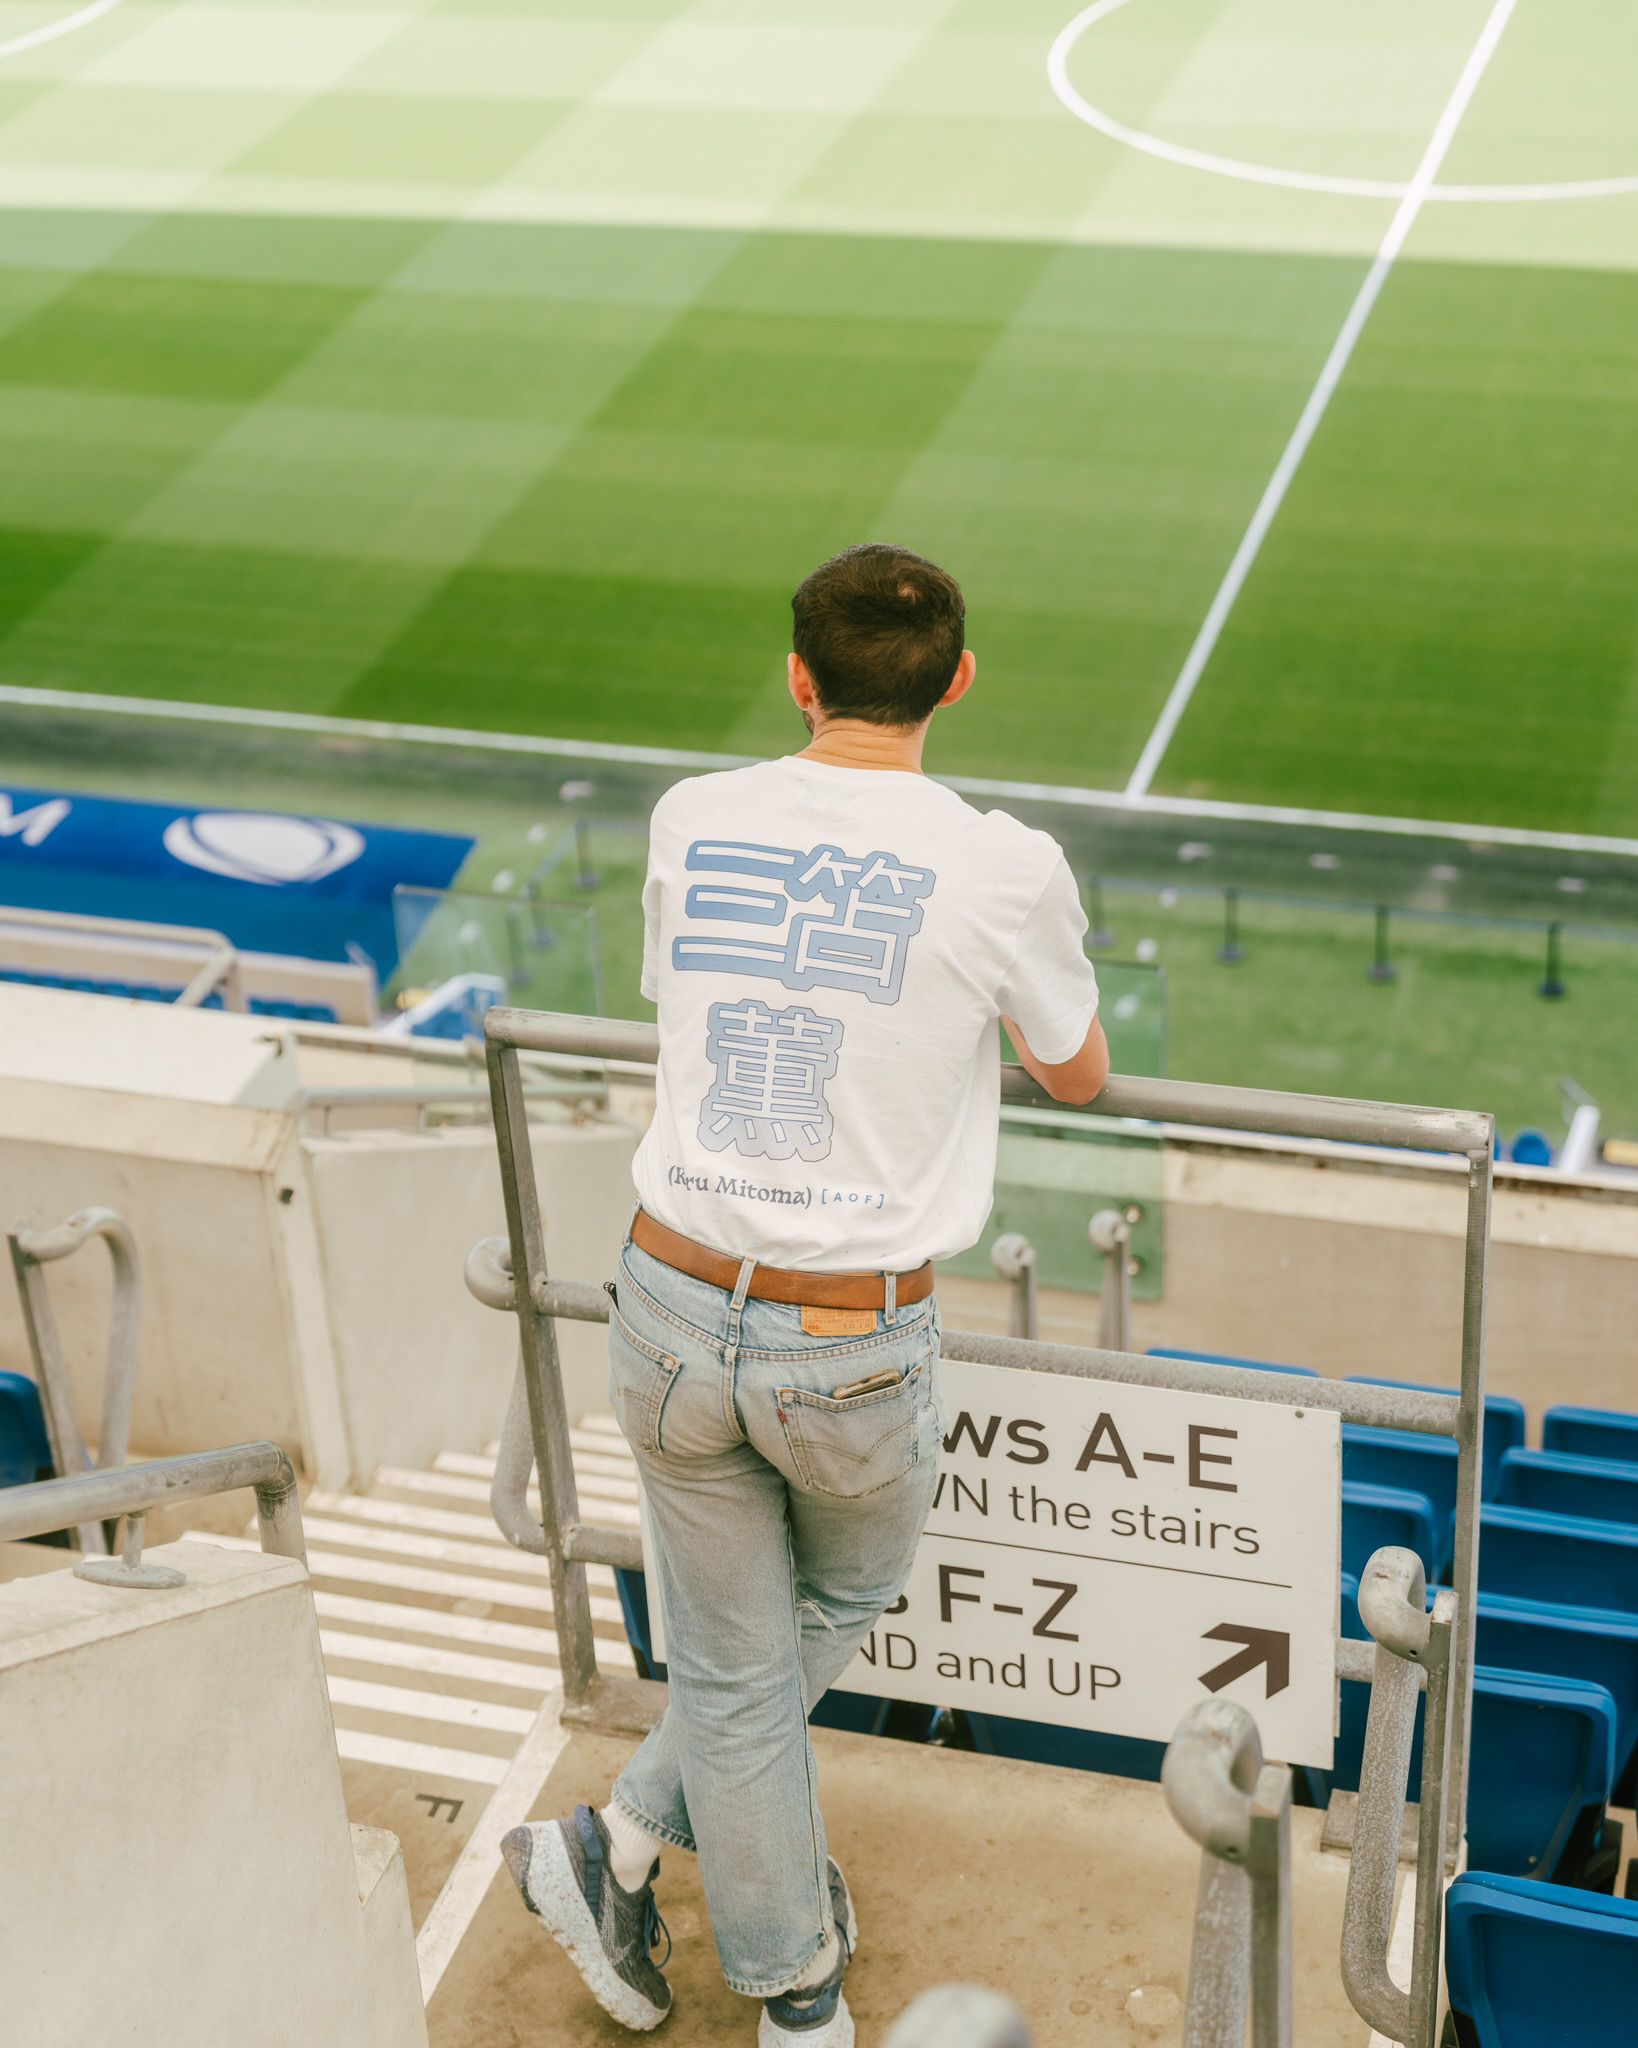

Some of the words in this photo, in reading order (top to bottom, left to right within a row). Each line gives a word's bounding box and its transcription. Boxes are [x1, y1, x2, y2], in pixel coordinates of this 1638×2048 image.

[715, 1175, 812, 1210] Mitoma)
[942, 1411, 1050, 1465] ws
[1008, 1485, 1092, 1530] the
[1111, 1504, 1260, 1555] stairs
[860, 1630, 917, 1670] ND
[936, 1651, 1027, 1690] and
[1048, 1657, 1122, 1700] UP
[415, 1793, 464, 1824] F
